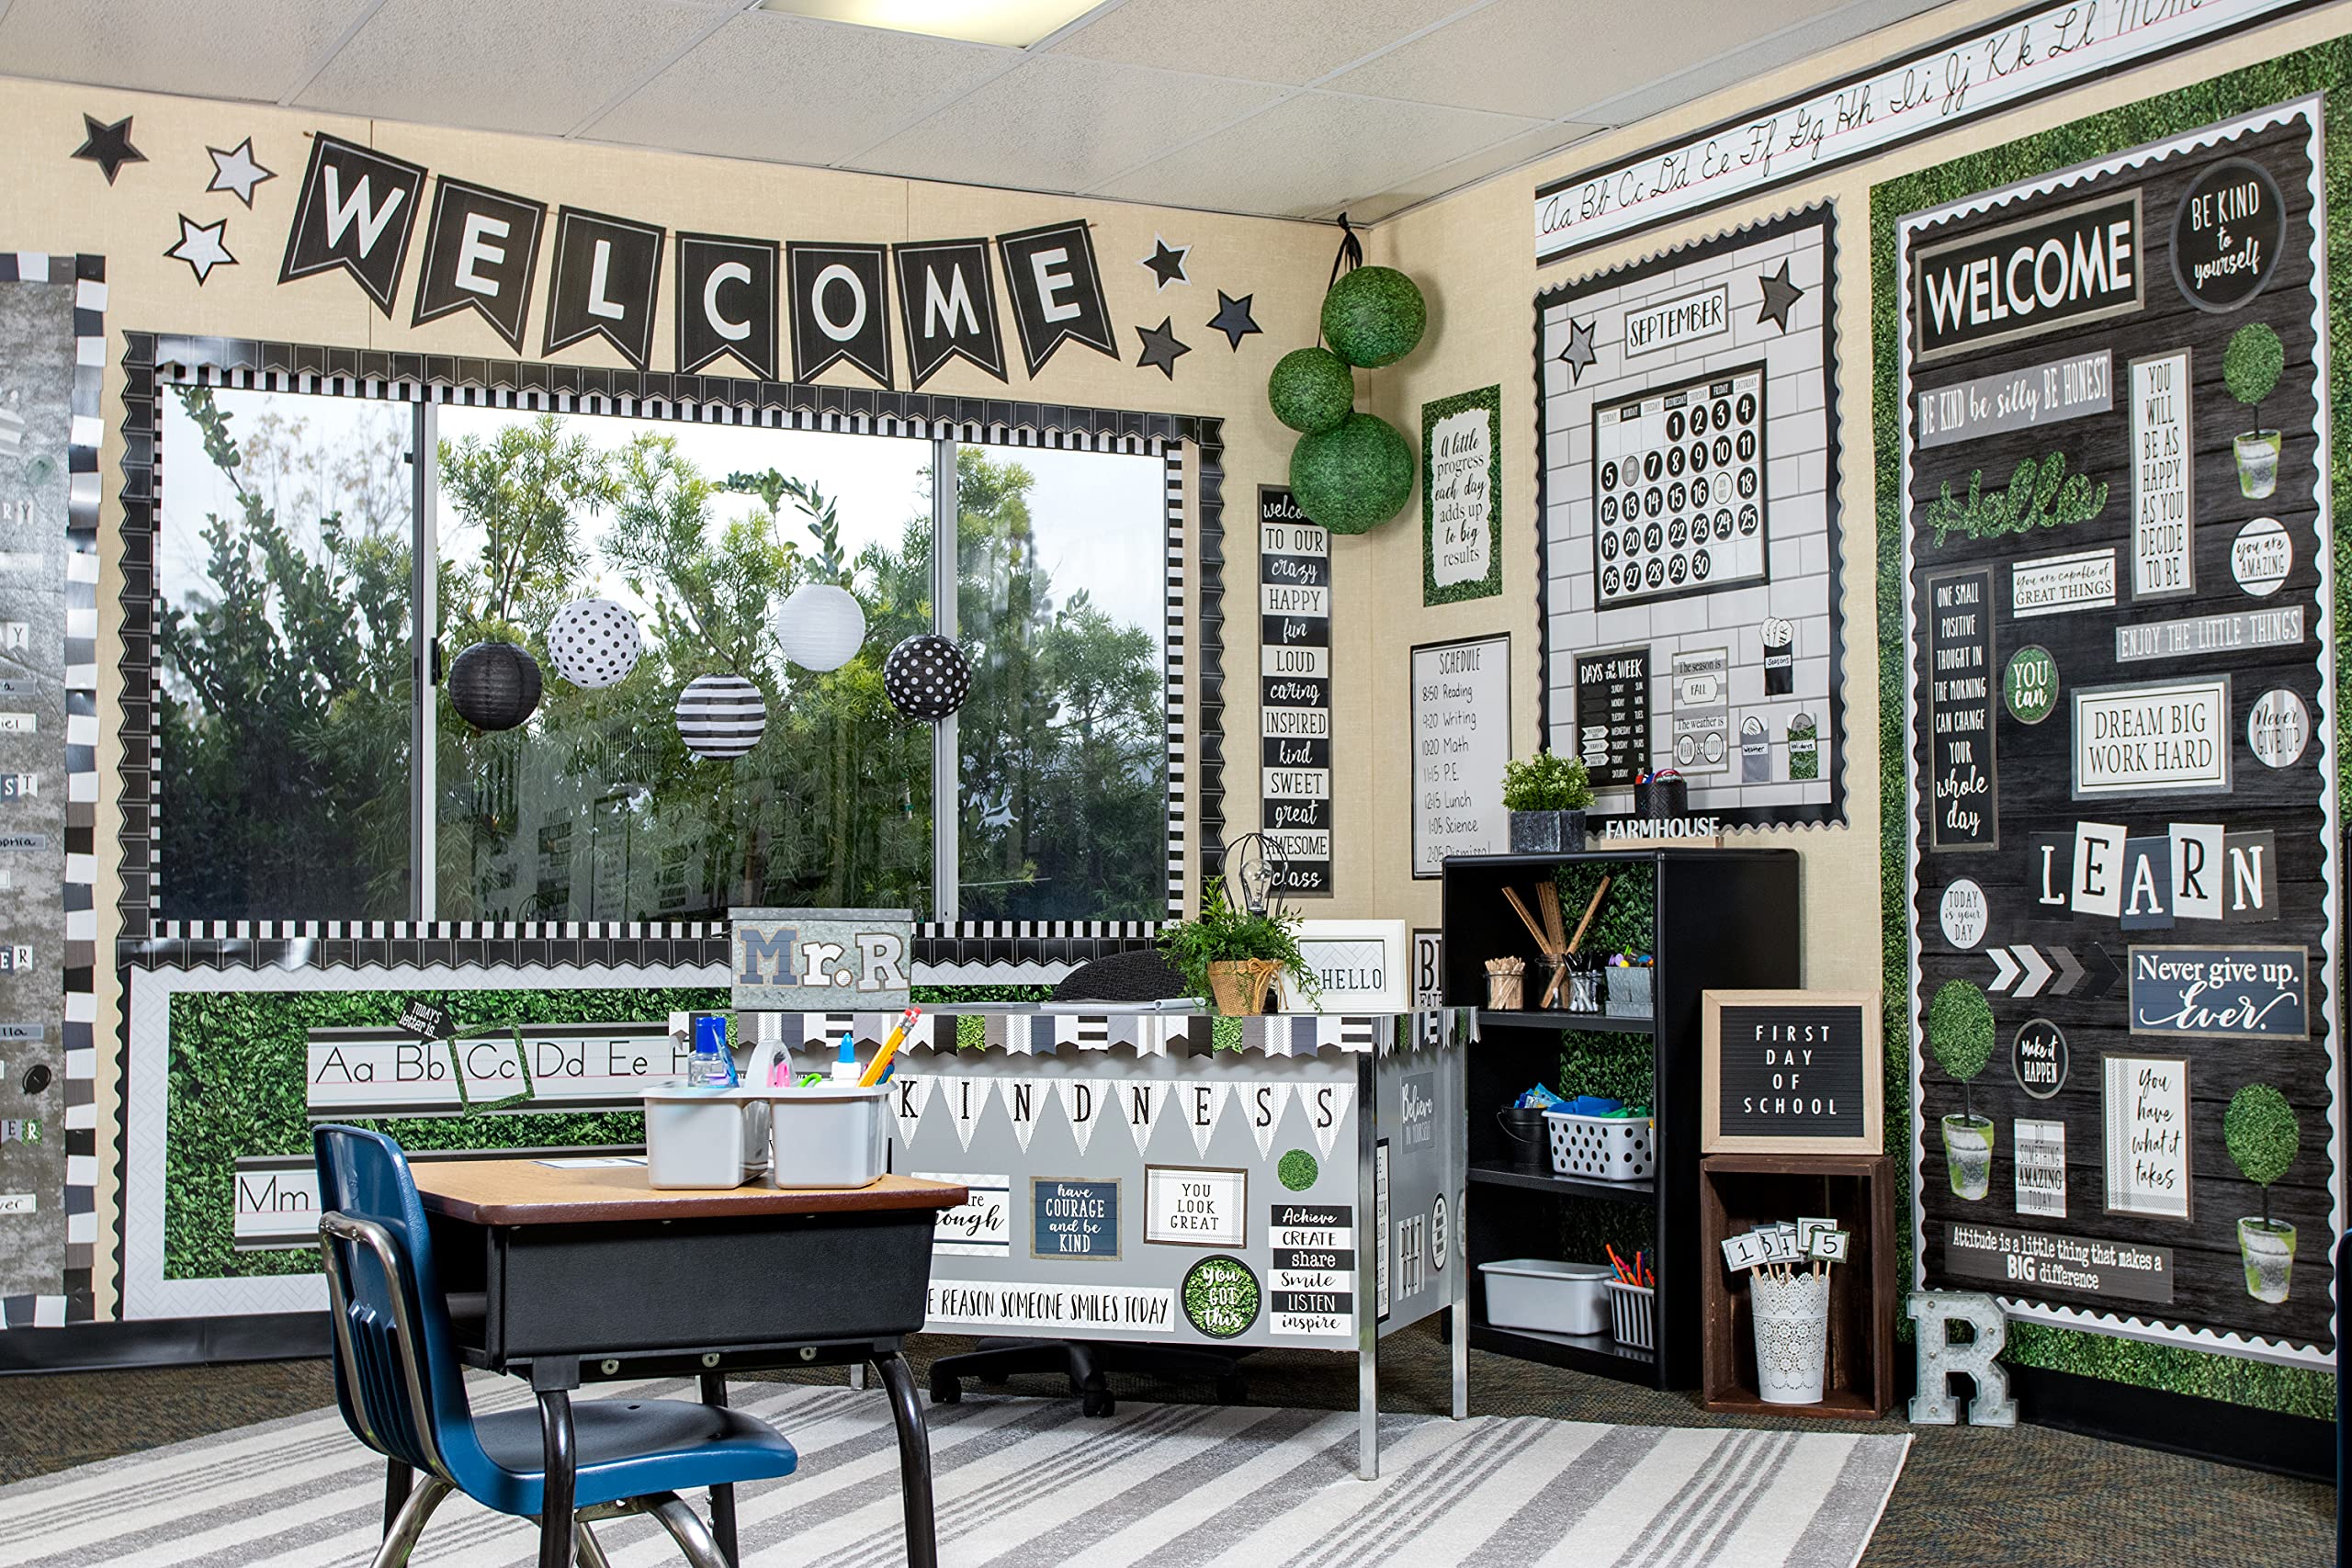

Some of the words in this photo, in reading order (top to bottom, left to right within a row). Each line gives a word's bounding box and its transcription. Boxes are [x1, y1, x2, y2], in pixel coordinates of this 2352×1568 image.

[1542, 197, 1572, 233] Aa
[1579, 179, 1611, 220] Bb
[1618, 171, 1644, 208] Cc
[1649, 151, 1690, 197] Dd
[1702, 141, 1730, 179] Ee
[1740, 118, 1778, 177] Ff
[1835, 85, 1874, 134] Hh
[1984, 25, 2035, 82] Kk
[2049, 1, 2095, 58] Ll
[2191, 194, 2211, 231] BE
[2218, 181, 2260, 222] KIND
[323, 164, 1081, 342] WELCOME
[2194, 238, 2261, 290] yourself
[1926, 220, 2132, 336] WELCOME
[1630, 294, 1724, 347] SEPTEMBER
[2148, 363, 2171, 393] YOU
[1939, 389, 1964, 431] KIND
[1997, 378, 2041, 418] silly
[2064, 355, 2108, 406] HONEST
[2146, 395, 2175, 426] WILL
[1452, 428, 1479, 456] little
[2143, 431, 2160, 458] BE
[2165, 425, 2179, 457] AS
[1437, 453, 1485, 481] progress
[1606, 467, 1614, 486] 5
[2143, 458, 2181, 492] HAPPY
[1435, 478, 1459, 502] each
[1464, 473, 1487, 497] day
[1603, 502, 1615, 520] 12
[1624, 496, 1638, 516] 13
[1669, 488, 1684, 507] 15
[1739, 475, 1753, 494] 18
[2141, 495, 2156, 525] AS
[2161, 491, 2184, 520] YOU
[1265, 528, 1284, 549] TO
[1295, 529, 1323, 551] OUR
[1625, 531, 1640, 550] 20
[1670, 524, 1685, 542] 22
[1716, 513, 1731, 533] 24
[1741, 508, 1757, 527] 25
[2141, 524, 2184, 557] DECIDE
[1443, 545, 1480, 567] results
[1647, 563, 1661, 582] 28
[1693, 555, 1709, 574] 30
[2240, 553, 2286, 579] AMAZING
[1272, 558, 1318, 584] crazy
[2146, 559, 2161, 587] TO
[2165, 557, 2180, 586] BE
[1269, 588, 1321, 612] HAPPY
[1938, 585, 1952, 607] ONE
[1955, 581, 1979, 605] SMALL
[2016, 582, 2056, 605] GREAT
[2060, 578, 2111, 599] THINGS
[1941, 613, 1976, 638] POSITIVE
[2120, 625, 2161, 658] ENJOY
[2166, 622, 2190, 651] THE
[2198, 616, 2243, 649] LITTLE
[2249, 610, 2299, 643] THINGS
[1276, 650, 1315, 673] LOUD
[1439, 647, 1481, 675] SCHEDULE
[1581, 663, 1603, 684] DAYS
[1617, 659, 1643, 680] WEEK
[1693, 660, 1714, 672] season
[1937, 649, 1970, 671] THOUGHT
[2013, 660, 2049, 687] YOU
[1422, 685, 1438, 702] 8:50
[1442, 682, 1473, 704] Reading
[1690, 682, 1708, 697] FALL
[1950, 676, 1986, 701] MORNING
[2014, 687, 2048, 709] can
[1266, 711, 1326, 735] INSPIRED
[1443, 710, 1476, 731] Writing
[1936, 712, 1952, 733] CAN
[1954, 707, 1985, 733] CHANGE
[2094, 706, 2165, 740] DREAM
[2171, 701, 2207, 734] BIG
[1443, 735, 1469, 753] Math
[1949, 740, 1972, 764] YOUR
[2088, 742, 2149, 775] WORK
[2154, 738, 2212, 772] HARD
[1272, 772, 1323, 795] SWEET
[1443, 762, 1459, 781] P.E.
[1935, 764, 1988, 796] whole
[1444, 790, 1472, 808] Lunch
[1275, 799, 1319, 828] great
[1445, 817, 1479, 834] Science
[1946, 799, 1981, 837] day
[1605, 817, 1720, 840] FARMHOUSE
[2039, 836, 2264, 916] LEARN
[1948, 889, 1978, 908] TODAY
[1954, 923, 1973, 942] DAY
[1321, 968, 1382, 989] HELLO
[2137, 954, 2204, 981] Never
[2209, 956, 2256, 990] give
[2261, 962, 2300, 990] up.
[411, 999, 442, 1026] TODAY'S
[2140, 980, 2298, 1031] Ever.
[397, 1014, 424, 1034] letter
[1756, 1025, 1830, 1043] FIRST
[315, 1046, 374, 1084] Aa
[396, 1044, 445, 1082] Bb
[467, 1043, 515, 1079] Cc
[537, 1042, 585, 1077] Dd
[609, 1040, 649, 1077] Ee
[1766, 1049, 1813, 1066] DAY
[1772, 1073, 1801, 1089] OF
[2024, 1062, 2058, 1084] HAPPEN
[2137, 1067, 2172, 1098] You
[900, 1080, 1332, 1128] KINDNESS
[1402, 1082, 1433, 1124] Believe
[1744, 1098, 1838, 1115] SCHOOL
[2136, 1097, 2175, 1123] have
[2132, 1129, 2166, 1156] what
[2018, 1167, 2063, 1190] AMAZING
[2135, 1160, 2177, 1189] takes
[239, 1175, 309, 1213] Mm
[1057, 1184, 1092, 1199] have
[1182, 1183, 1211, 1198] YOU
[1046, 1199, 1105, 1218] COURAGE
[1177, 1199, 1216, 1214] LOOK
[1282, 1207, 1338, 1226] Achieve
[1049, 1219, 1080, 1234] and
[1083, 1220, 1101, 1234] be
[1170, 1215, 1218, 1231] GREAT
[1058, 1234, 1091, 1254] KIND
[1283, 1230, 1337, 1247] CREATE
[1822, 1234, 1838, 1255] 5
[1952, 1226, 1997, 1251] Attitude
[2020, 1235, 2055, 1257] little
[2057, 1240, 2089, 1267] thing
[2118, 1248, 2152, 1271] makes
[1291, 1251, 1336, 1268] share
[2007, 1254, 2035, 1281] BIG
[2040, 1262, 2099, 1290] difference
[1281, 1270, 1336, 1288] Smile
[942, 1289, 995, 1318] REASON
[1001, 1291, 1063, 1321] SOMEONE
[1070, 1293, 1118, 1323] SMILES
[1125, 1297, 1169, 1325] TODAY
[1209, 1286, 1237, 1306] GOT
[1288, 1293, 1335, 1313] LISTEN
[1204, 1305, 1243, 1328] this
[1282, 1314, 1340, 1333] inspire
[1907, 1290, 2019, 1426] R
